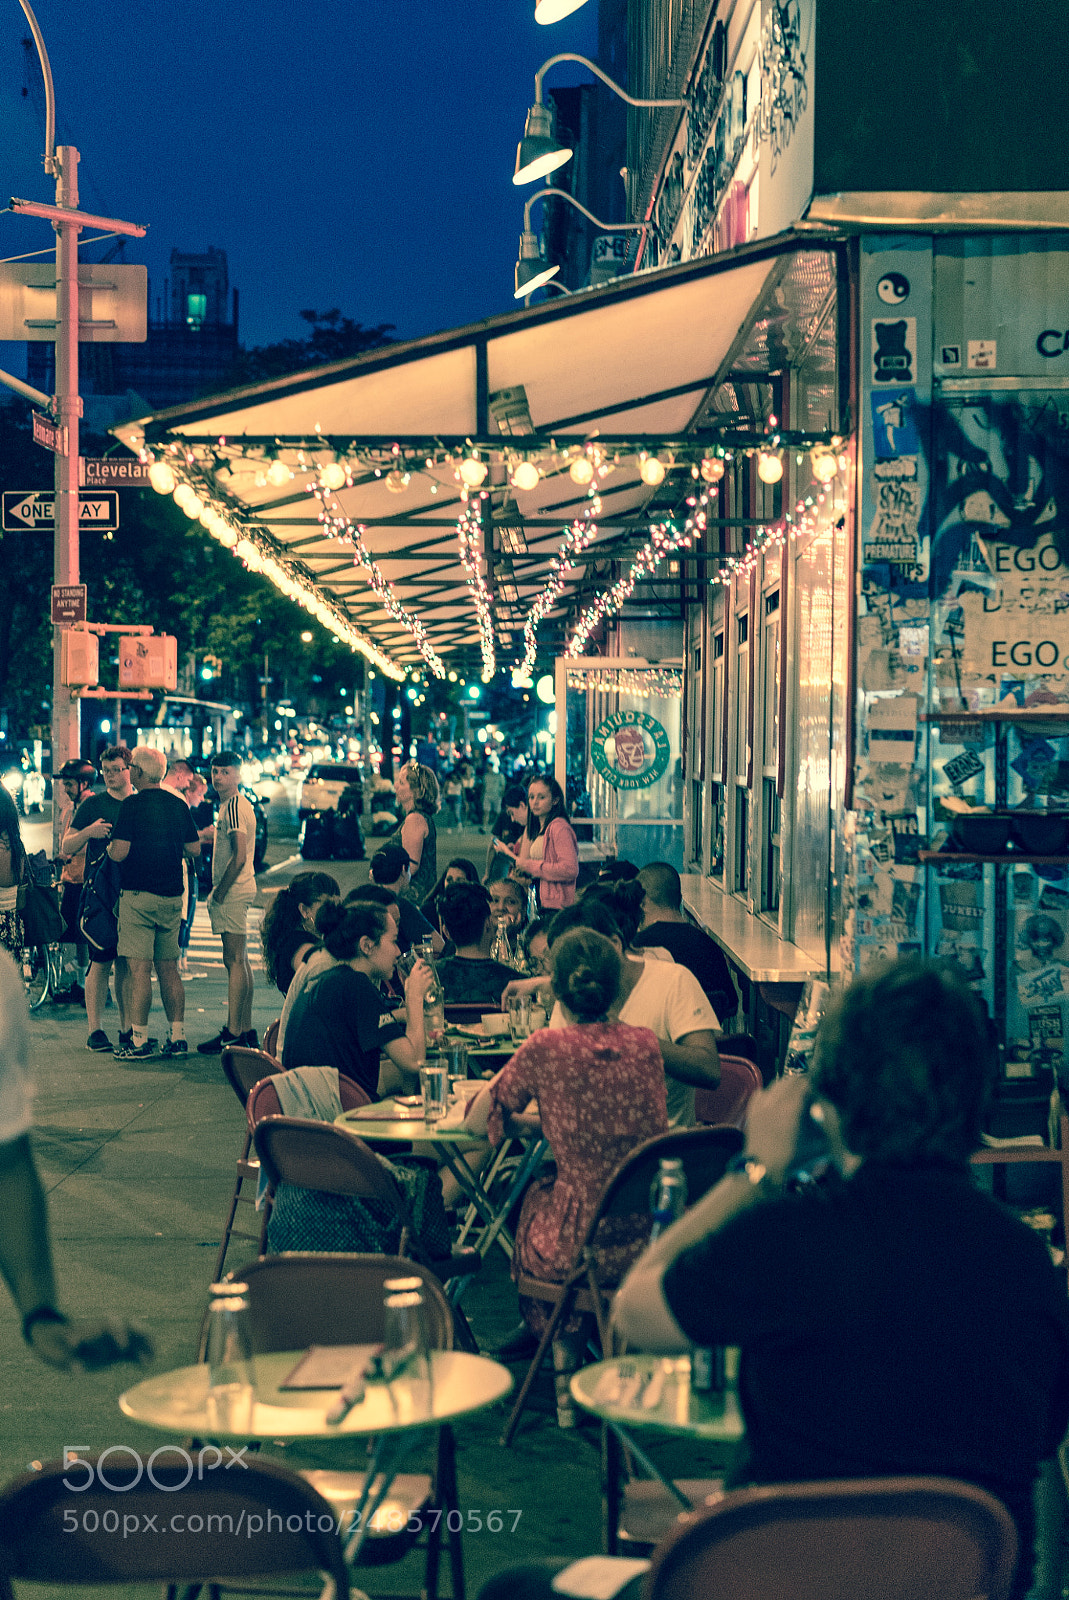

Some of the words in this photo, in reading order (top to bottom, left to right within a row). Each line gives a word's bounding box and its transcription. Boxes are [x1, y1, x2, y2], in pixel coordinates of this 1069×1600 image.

[86, 462, 152, 478] Clevelan
[86, 477, 107, 485] Place
[20, 503, 52, 518] ONE
[79, 503, 102, 518] AY
[864, 543, 917, 561] PREMATURE
[995, 544, 1062, 572] EGO
[53, 589, 61, 598] NO
[61, 588, 84, 598] STANDING
[56, 598, 80, 608] ANYTIME
[991, 640, 1060, 667] EGO
